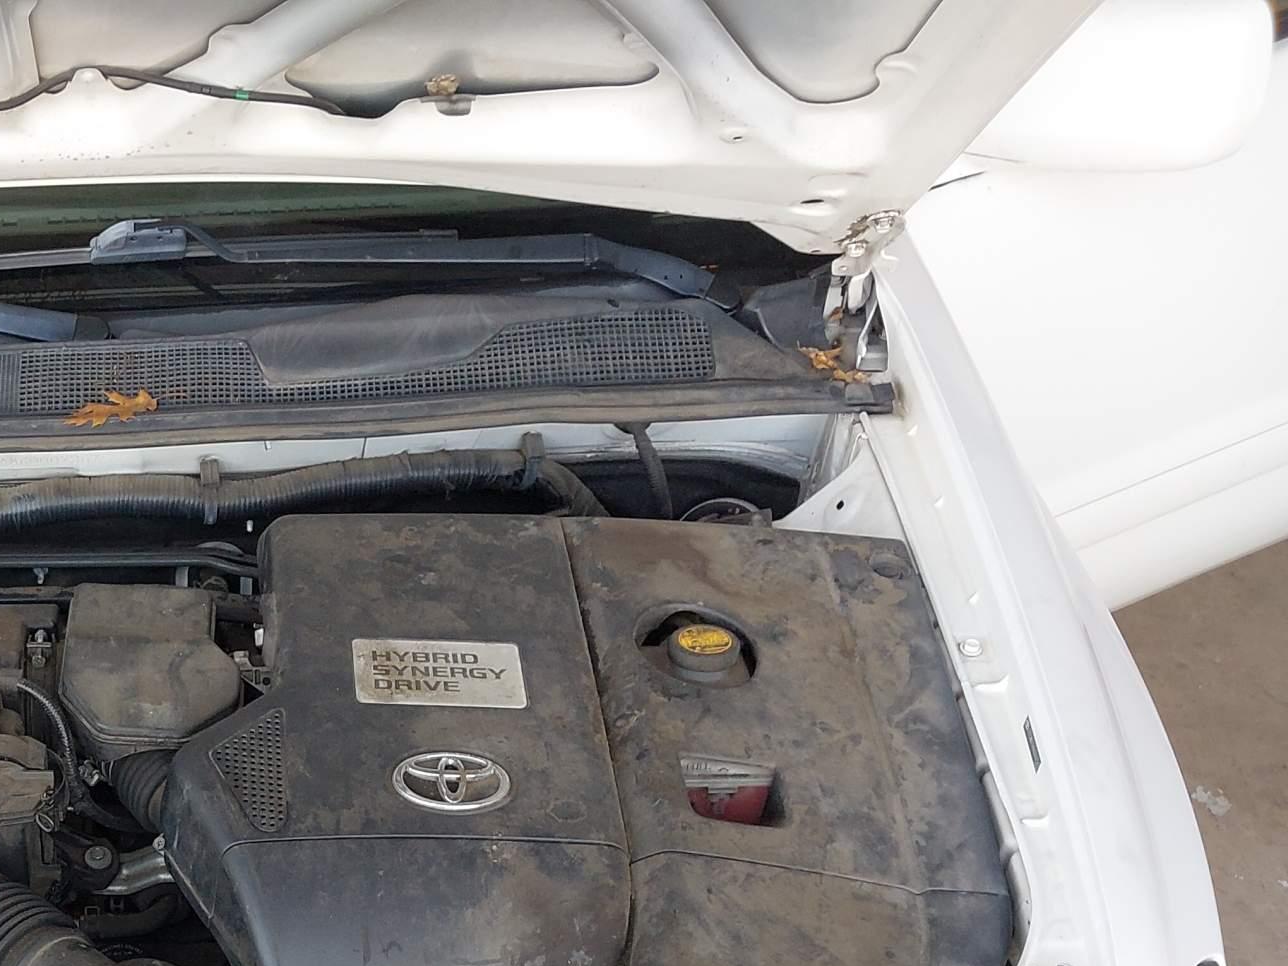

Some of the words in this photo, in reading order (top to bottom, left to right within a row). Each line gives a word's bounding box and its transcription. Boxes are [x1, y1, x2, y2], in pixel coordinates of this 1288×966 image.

[371, 650, 479, 665] HYBRID
[372, 664, 507, 680] SYNERGY
[374, 679, 461, 693] DRIVE
